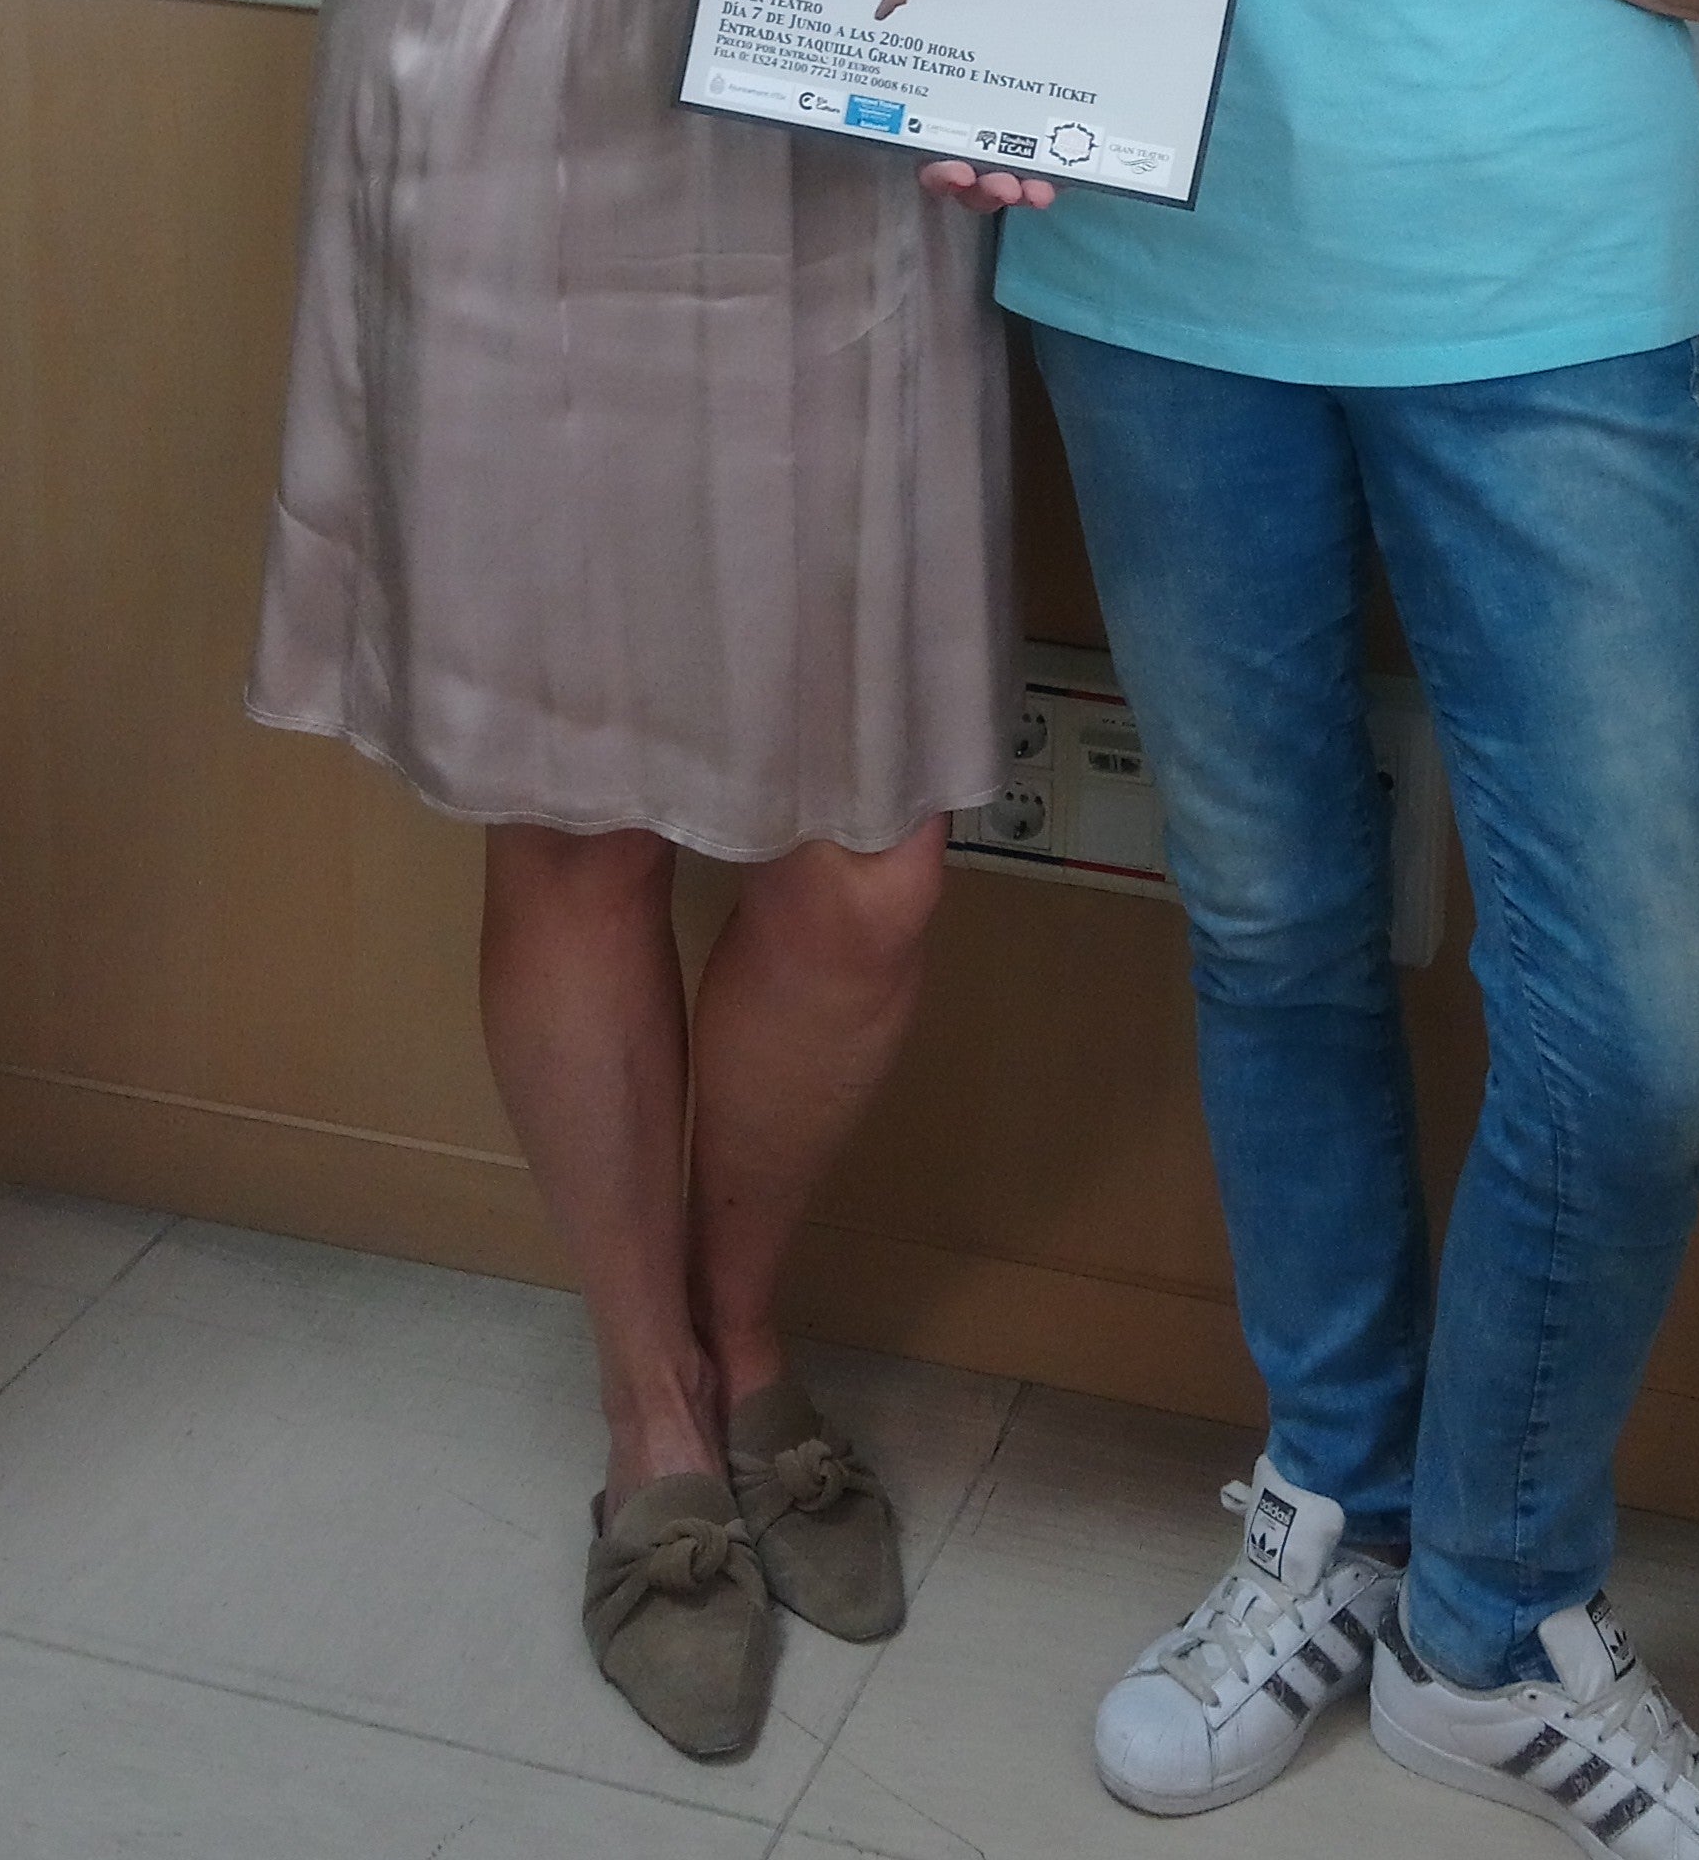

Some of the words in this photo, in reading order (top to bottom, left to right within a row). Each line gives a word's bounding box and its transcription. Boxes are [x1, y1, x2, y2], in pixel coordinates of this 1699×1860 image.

[751, 6, 763, 20] 7
[766, 11, 786, 25] DE
[788, 13, 832, 34] JUNIO
[837, 25, 845, 38] A
[849, 27, 876, 43] LAS
[879, 31, 924, 51] 20:00
[926, 42, 976, 63] HORAS
[718, 18, 793, 45] ENTRADAS
[797, 35, 863, 59] TAQUILLA
[868, 47, 908, 67] GRAN
[912, 55, 966, 79] TEATRO
[969, 69, 980, 82] E
[983, 69, 1045, 95] INSTANT
[1048, 81, 1098, 106] TICKET
[780, 59, 808, 73] 2100
[810, 65, 837, 80] 7721
[840, 71, 868, 86] 3102
[900, 83, 930, 98] 6162
[832, 56, 845, 68] 10
